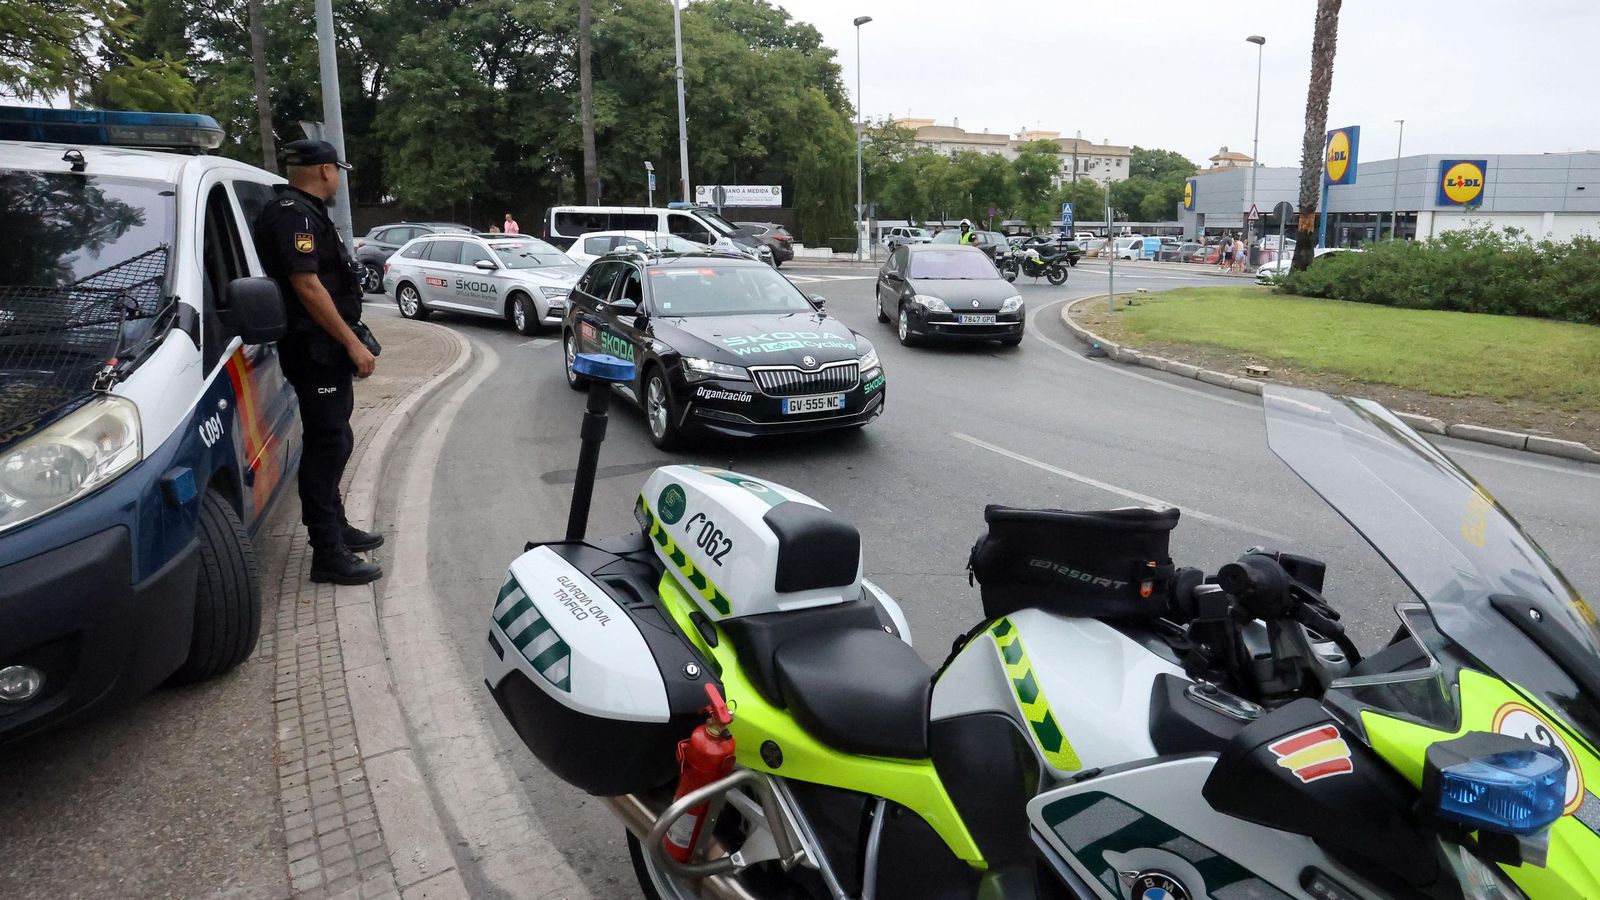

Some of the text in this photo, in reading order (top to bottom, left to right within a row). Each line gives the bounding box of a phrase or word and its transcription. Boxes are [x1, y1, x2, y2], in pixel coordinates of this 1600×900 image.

[732, 340, 857, 356] We Love Cycling
[696, 386, 752, 402] Organización
[557, 575, 612, 627] GUARDIA CIVIL
[1143, 877, 1185, 900] BM
